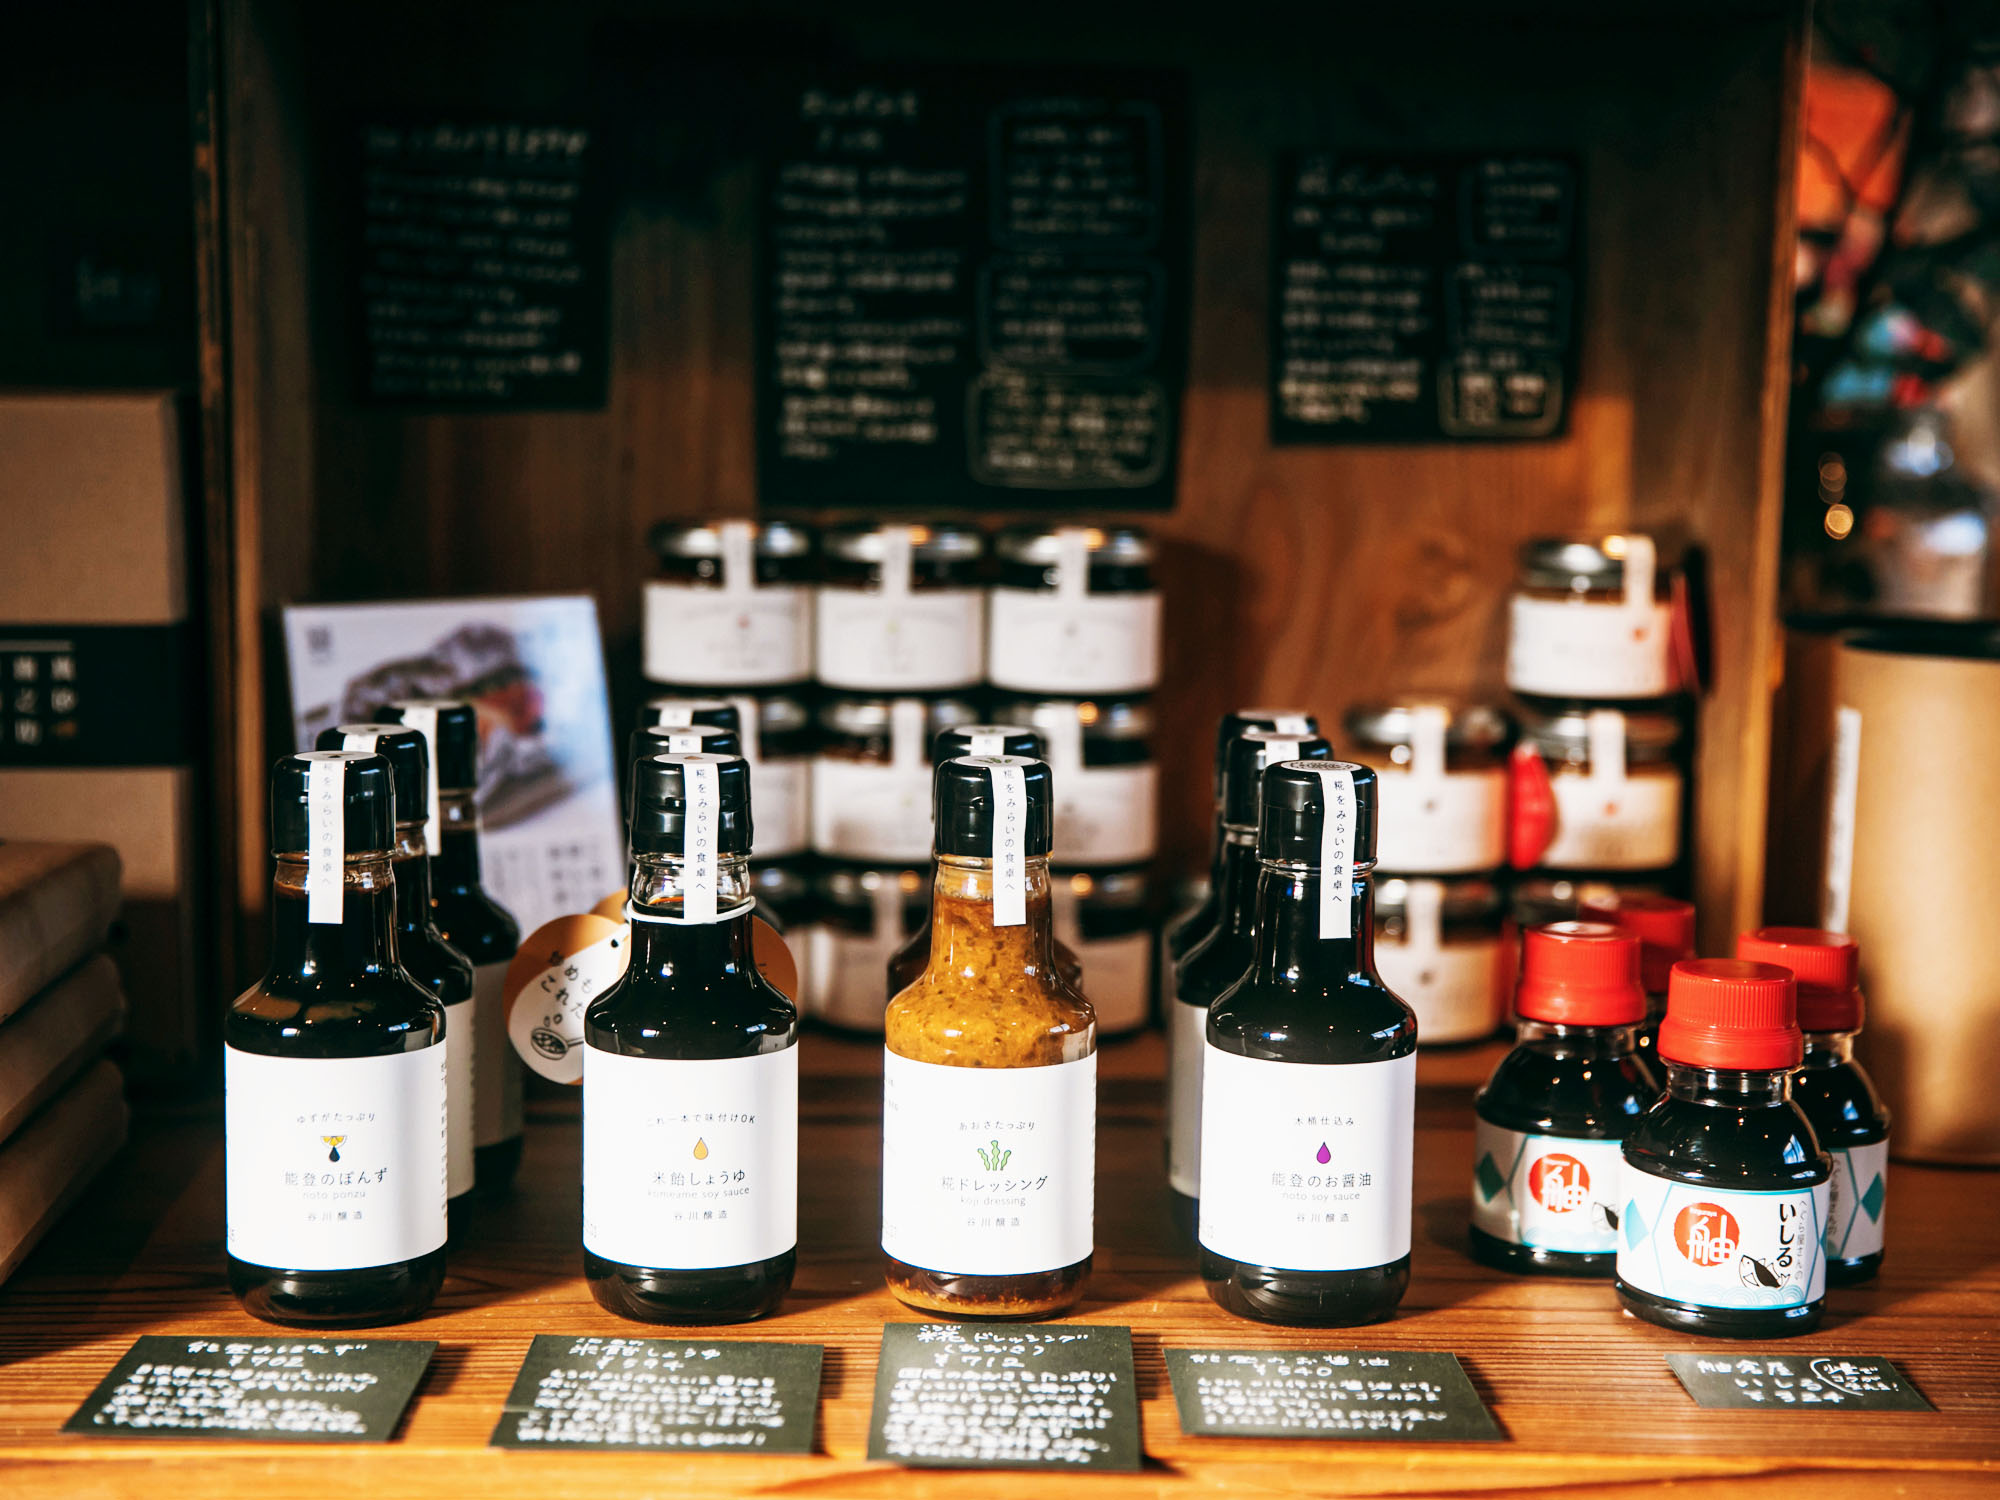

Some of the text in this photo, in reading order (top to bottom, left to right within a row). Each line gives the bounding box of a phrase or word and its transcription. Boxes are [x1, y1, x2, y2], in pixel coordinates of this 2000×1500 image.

[696, 768, 709, 890] 糀をみらいの食卓へ
[1003, 768, 1018, 890] 糀をみらいの食卓へ
[1331, 779, 1347, 903] 糀をみらいの食卓へ
[959, 1119, 1036, 1132] あおさたっぷり
[1294, 1115, 1355, 1127] 木桶仕込み
[651, 1168, 746, 1187] 米飴しょうゆ
[940, 1174, 1049, 1193] 糀ドレッシング
[1271, 1171, 1373, 1189] 能登のお醤油
[701, 1190, 720, 1201] soy
[723, 1186, 751, 1198] sauce
[983, 1195, 1027, 1207] dressing
[1281, 1191, 1361, 1203] noto soy sauce
[1776, 1203, 1798, 1268] いしる
